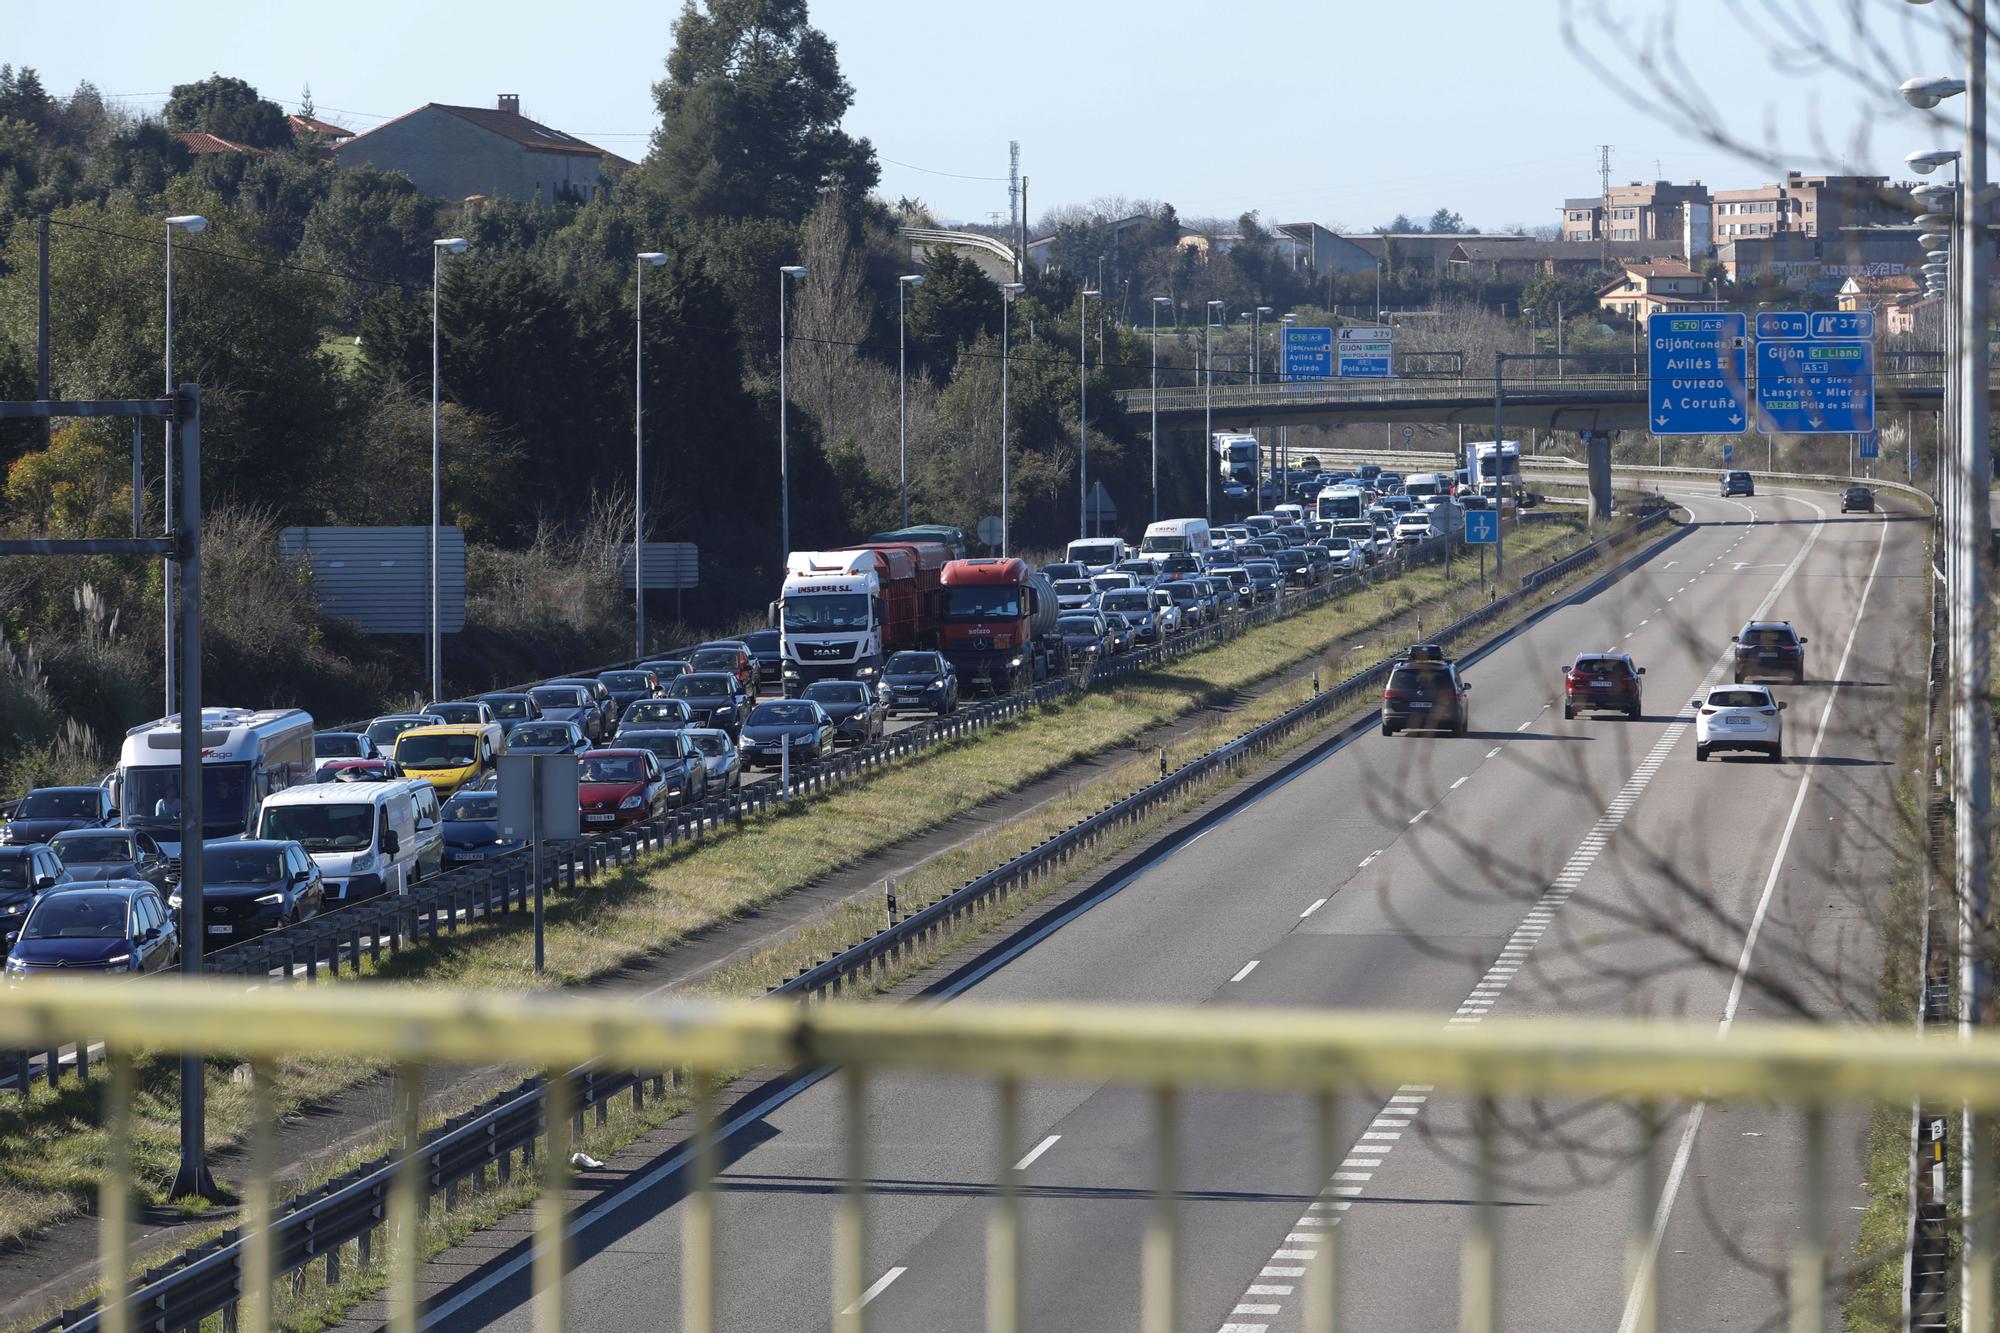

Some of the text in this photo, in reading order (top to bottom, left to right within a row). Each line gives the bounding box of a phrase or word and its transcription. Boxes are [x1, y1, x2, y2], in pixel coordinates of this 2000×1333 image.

[1762, 321, 1789, 330] 400
[1840, 319, 1867, 329] 379
[1655, 337, 1690, 352] Gijón
[1768, 347, 1859, 361] Gijón El Llano
[1666, 357, 1712, 369] Avilés
[1672, 378, 1724, 389] Oviedo
[1777, 376, 1804, 384] Pola
[1810, 376, 1820, 384] de
[1763, 388, 1813, 399] Langreo
[1826, 388, 1868, 397] Mieres
[1662, 397, 1736, 409] A Coruña
[1801, 401, 1825, 409] Pola
[1827, 401, 1837, 409] de
